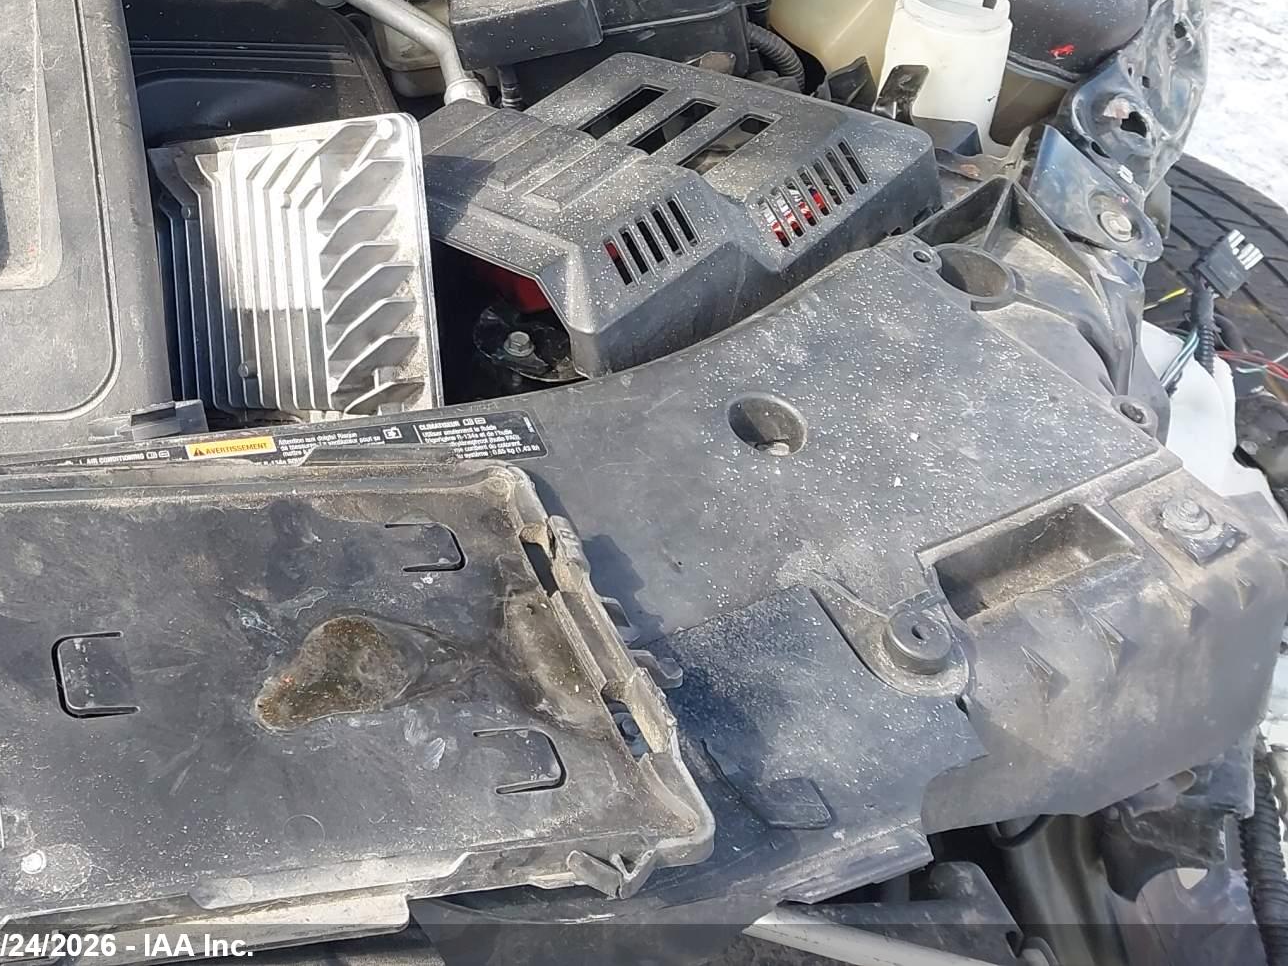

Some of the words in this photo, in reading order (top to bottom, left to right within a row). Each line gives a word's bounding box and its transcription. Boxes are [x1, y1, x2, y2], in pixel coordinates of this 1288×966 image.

[206, 442, 267, 455] AVERTISSEMENT
[87, 457, 99, 465] AIR
[99, 452, 145, 464] CONDITIONING
